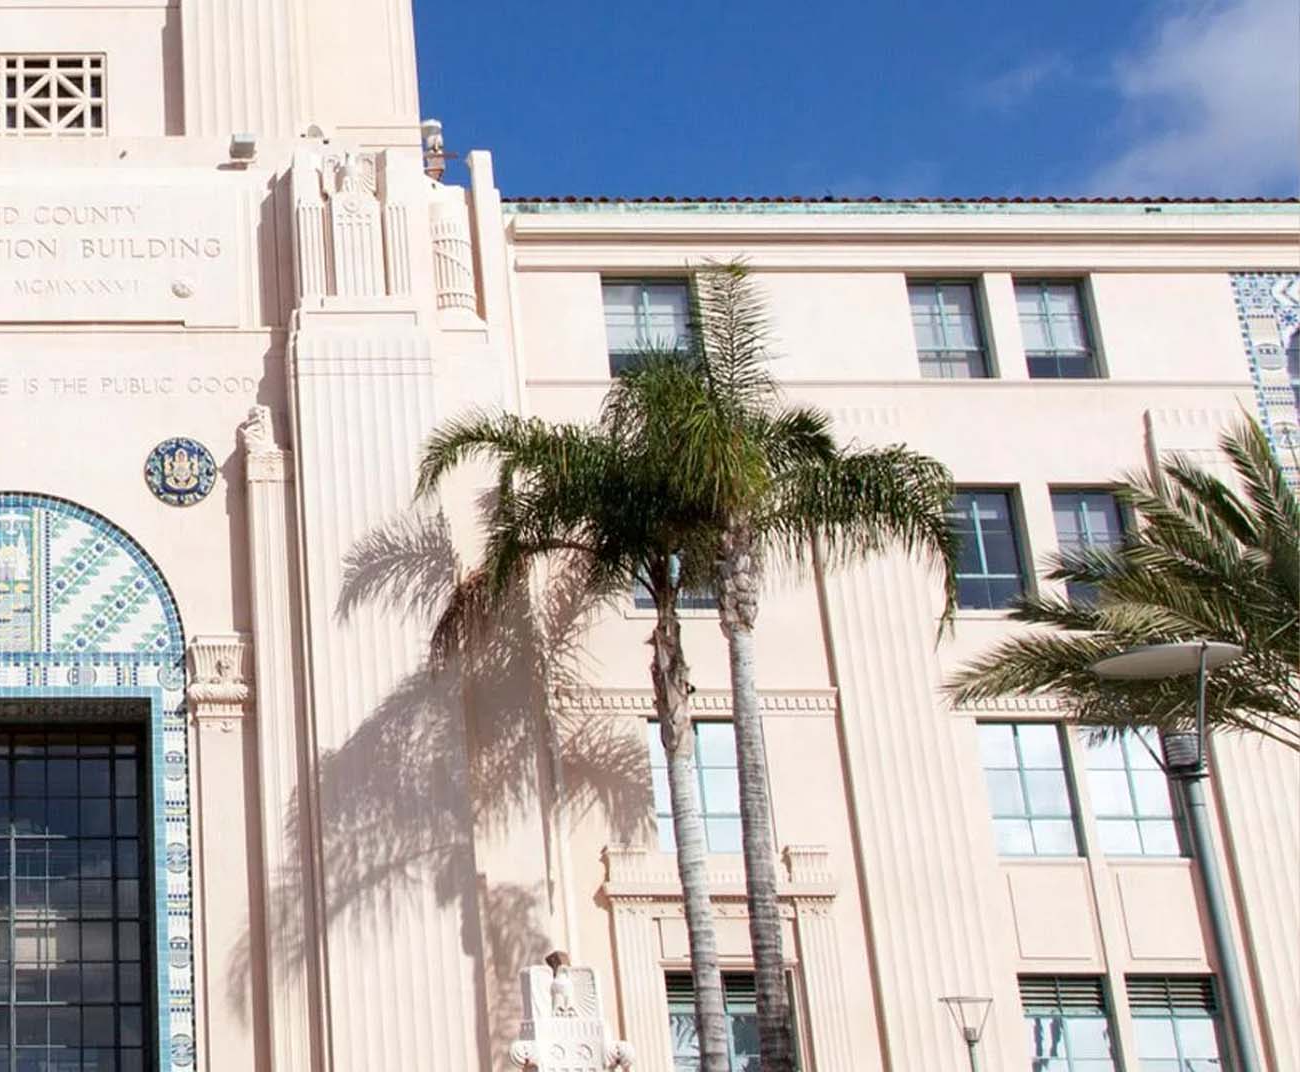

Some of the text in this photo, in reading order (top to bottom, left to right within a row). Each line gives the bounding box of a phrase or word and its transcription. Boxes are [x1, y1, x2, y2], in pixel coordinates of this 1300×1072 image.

[33, 205, 141, 226] COUNTY
[80, 238, 222, 260] BUILDING
[12, 278, 141, 297] MCMXXXVI
[22, 378, 40, 396] IS
[48, 377, 88, 396] THE
[100, 377, 173, 396] PUBLIC
[186, 377, 257, 395] GOOD
